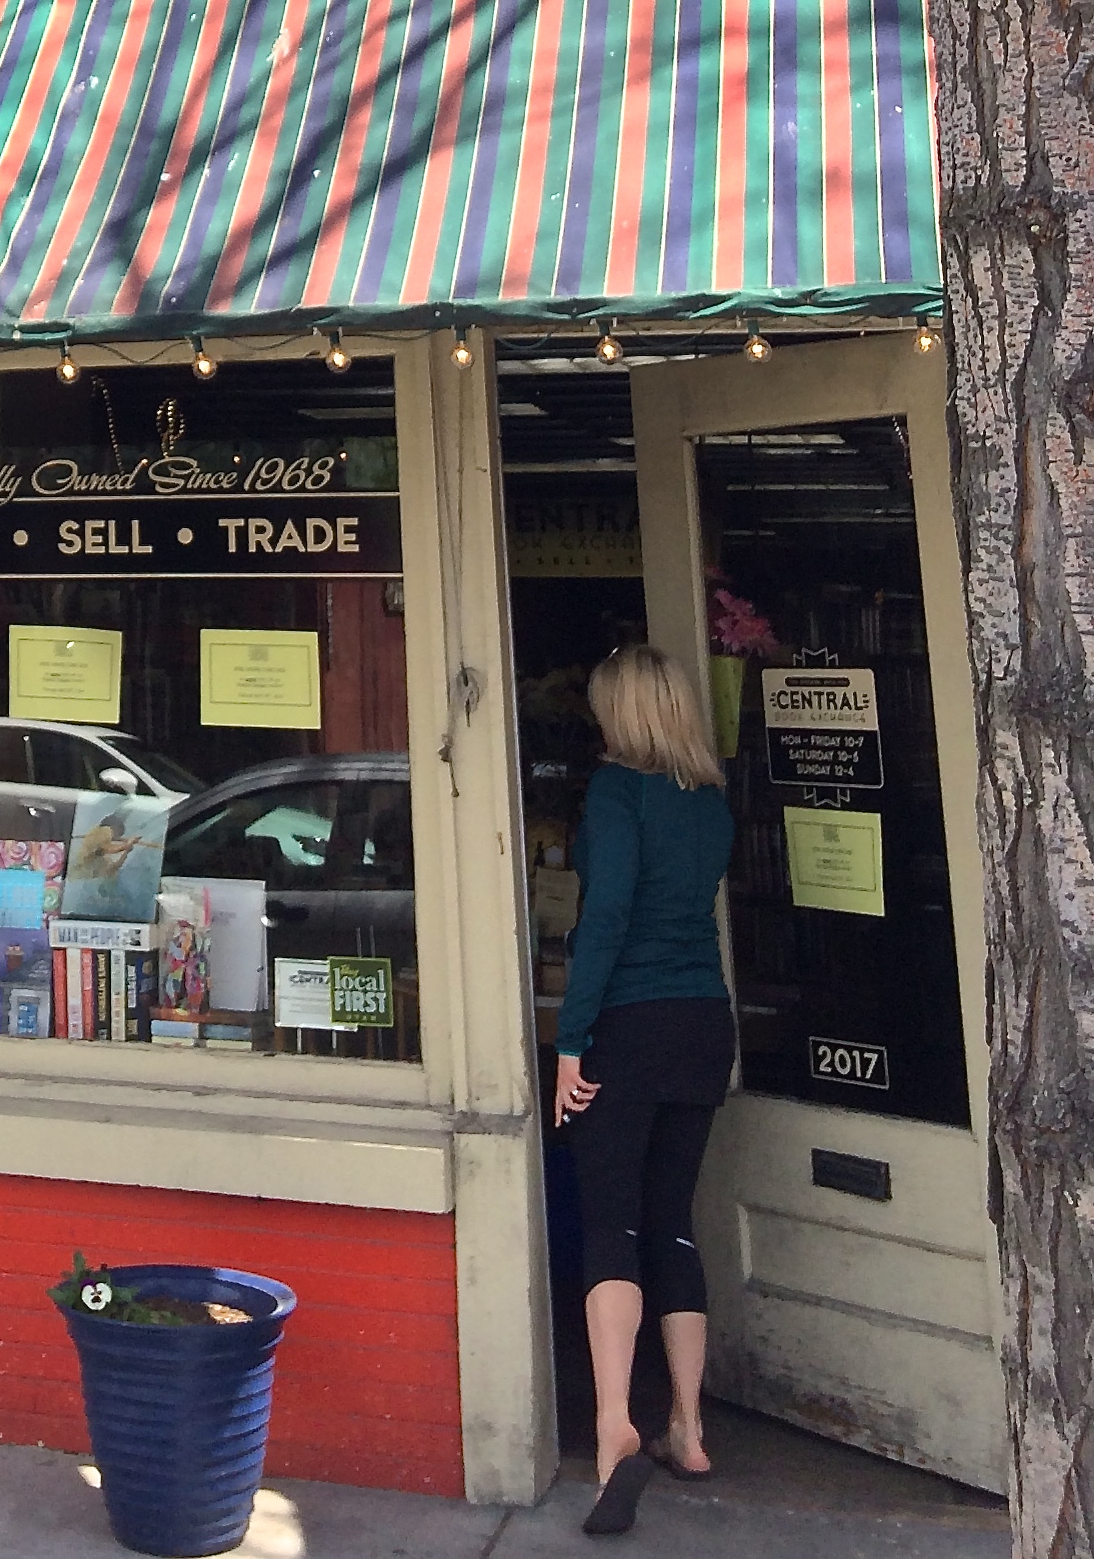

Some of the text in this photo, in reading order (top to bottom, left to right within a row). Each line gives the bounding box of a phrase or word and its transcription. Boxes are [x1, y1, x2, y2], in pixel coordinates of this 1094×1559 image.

[31, 458, 138, 494] Owned
[148, 456, 238, 494] Since
[242, 456, 335, 491] 1968
[57, 520, 153, 554] SELL
[218, 518, 360, 553] TRADE
[776, 689, 864, 711] CENTRAL
[810, 735, 842, 748] FRIDAY
[788, 749, 834, 762] SATURDAY
[796, 764, 831, 776] SUNDAY
[332, 968, 386, 991] local
[334, 990, 387, 1013] FIRST
[817, 1044, 879, 1080] 2017
